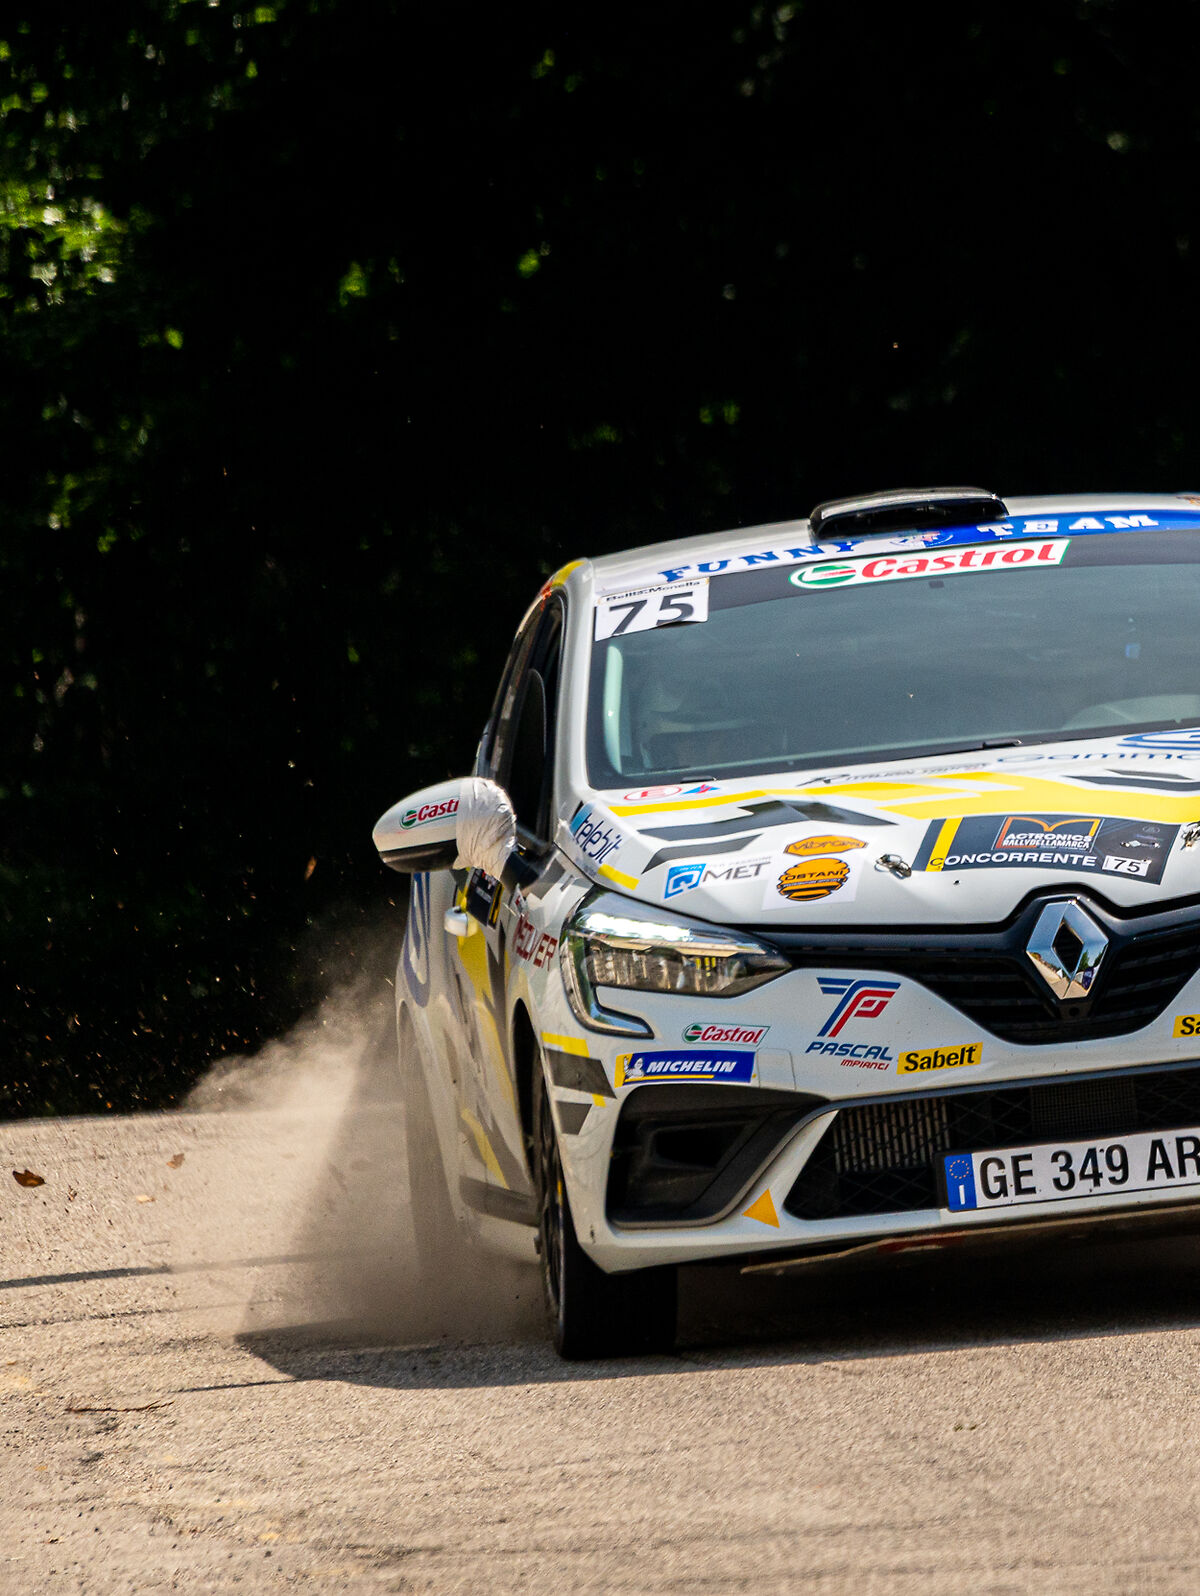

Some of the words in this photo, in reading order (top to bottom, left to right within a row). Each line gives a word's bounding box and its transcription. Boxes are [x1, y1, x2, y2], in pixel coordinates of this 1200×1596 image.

[976, 514, 1159, 537] TEAM
[657, 540, 865, 583] FUNNY
[861, 542, 1056, 579] Castrol
[609, 591, 694, 636] 75
[417, 799, 460, 822] Castr
[929, 851, 1097, 867] CONCORRENTE
[1113, 857, 1142, 873] 75
[701, 1025, 764, 1043] Castrol
[805, 1041, 893, 1061] PASCAL
[904, 1046, 976, 1071] Sabelt
[646, 1061, 737, 1073] MICHELIN
[979, 1153, 1038, 1201] GE
[1050, 1143, 1130, 1192] 349
